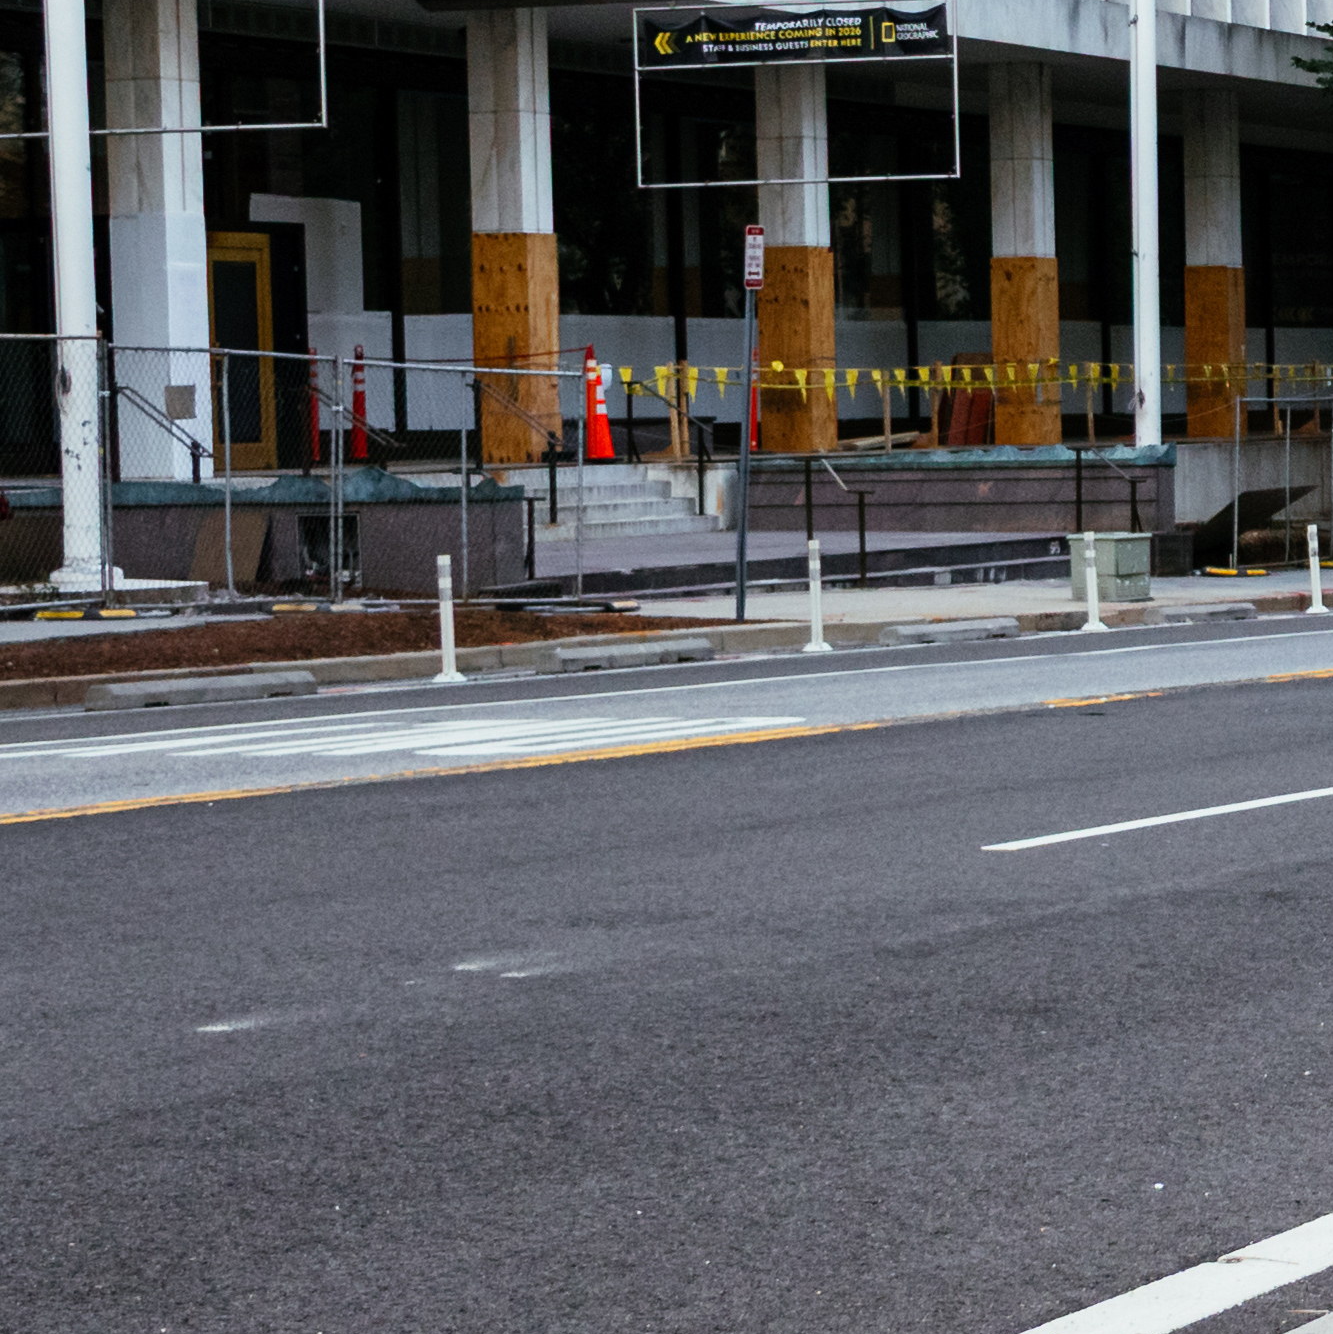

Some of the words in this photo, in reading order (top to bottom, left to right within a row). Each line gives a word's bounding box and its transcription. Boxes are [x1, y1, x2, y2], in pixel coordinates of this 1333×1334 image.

[755, 18, 824, 31] TEMPORARILY
[826, 18, 862, 27] CLOSED
[685, 35, 693, 43] A
[695, 33, 716, 42] NEW
[720, 31, 776, 42] EXPERIENCE
[778, 28, 822, 39] COMING
[825, 28, 836, 36] IN
[839, 27, 862, 36] 2026
[736, 43, 773, 52] BUSINESS
[775, 41, 808, 50] GUESTS
[810, 39, 838, 48] ENTER
[840, 38, 862, 46] HERE
